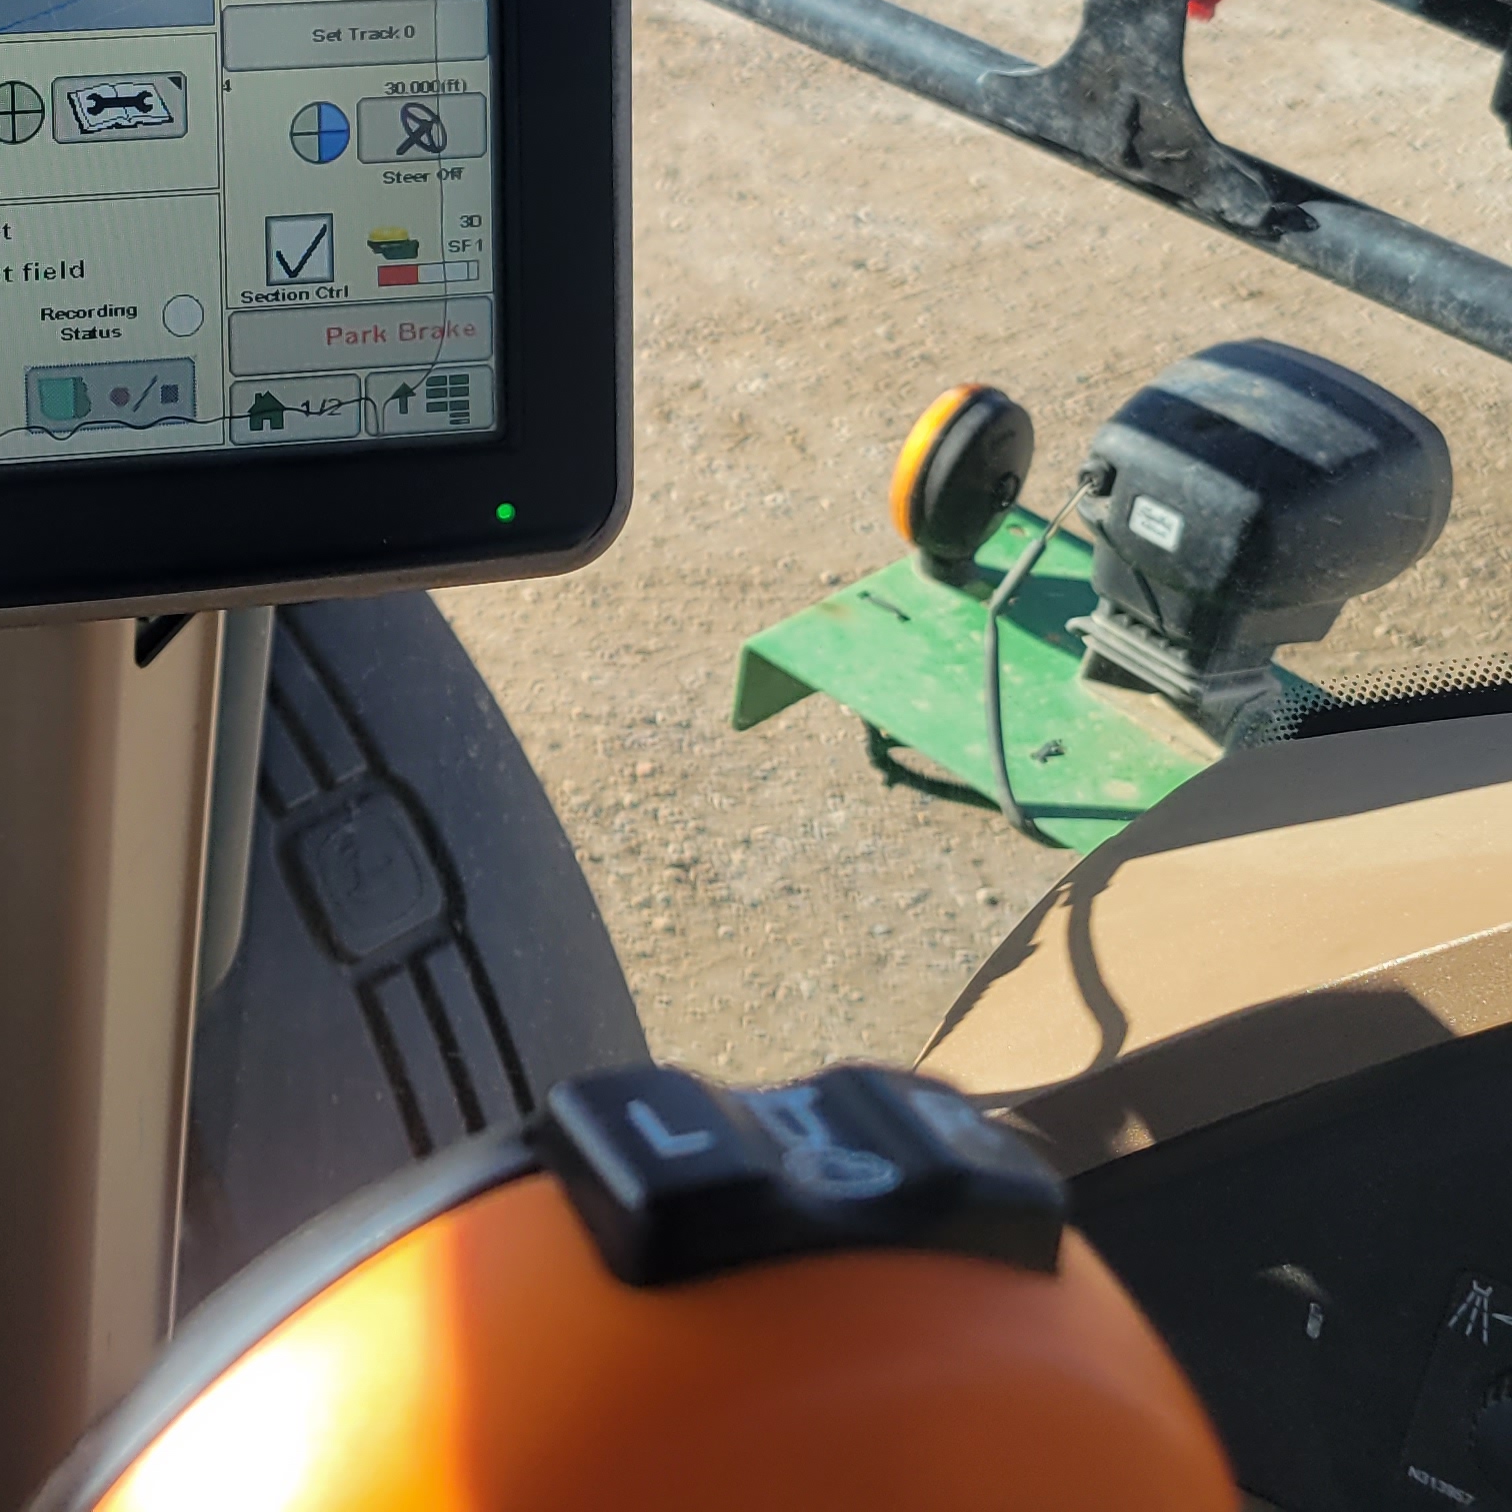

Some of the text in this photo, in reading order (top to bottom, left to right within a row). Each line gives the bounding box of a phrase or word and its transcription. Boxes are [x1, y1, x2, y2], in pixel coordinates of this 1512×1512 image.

[312, 28, 342, 42] Set
[348, 26, 399, 40] Track
[383, 167, 465, 184] Steer Off
[459, 215, 482, 228] 3D
[448, 240, 484, 253] SF1
[22, 260, 86, 280] field
[240, 286, 349, 304] Section Ctrl
[40, 304, 138, 321] Recording
[60, 326, 122, 341] Status
[326, 320, 477, 346] Park Brake
[301, 398, 342, 416] 1/2
[626, 1099, 715, 1159] L
